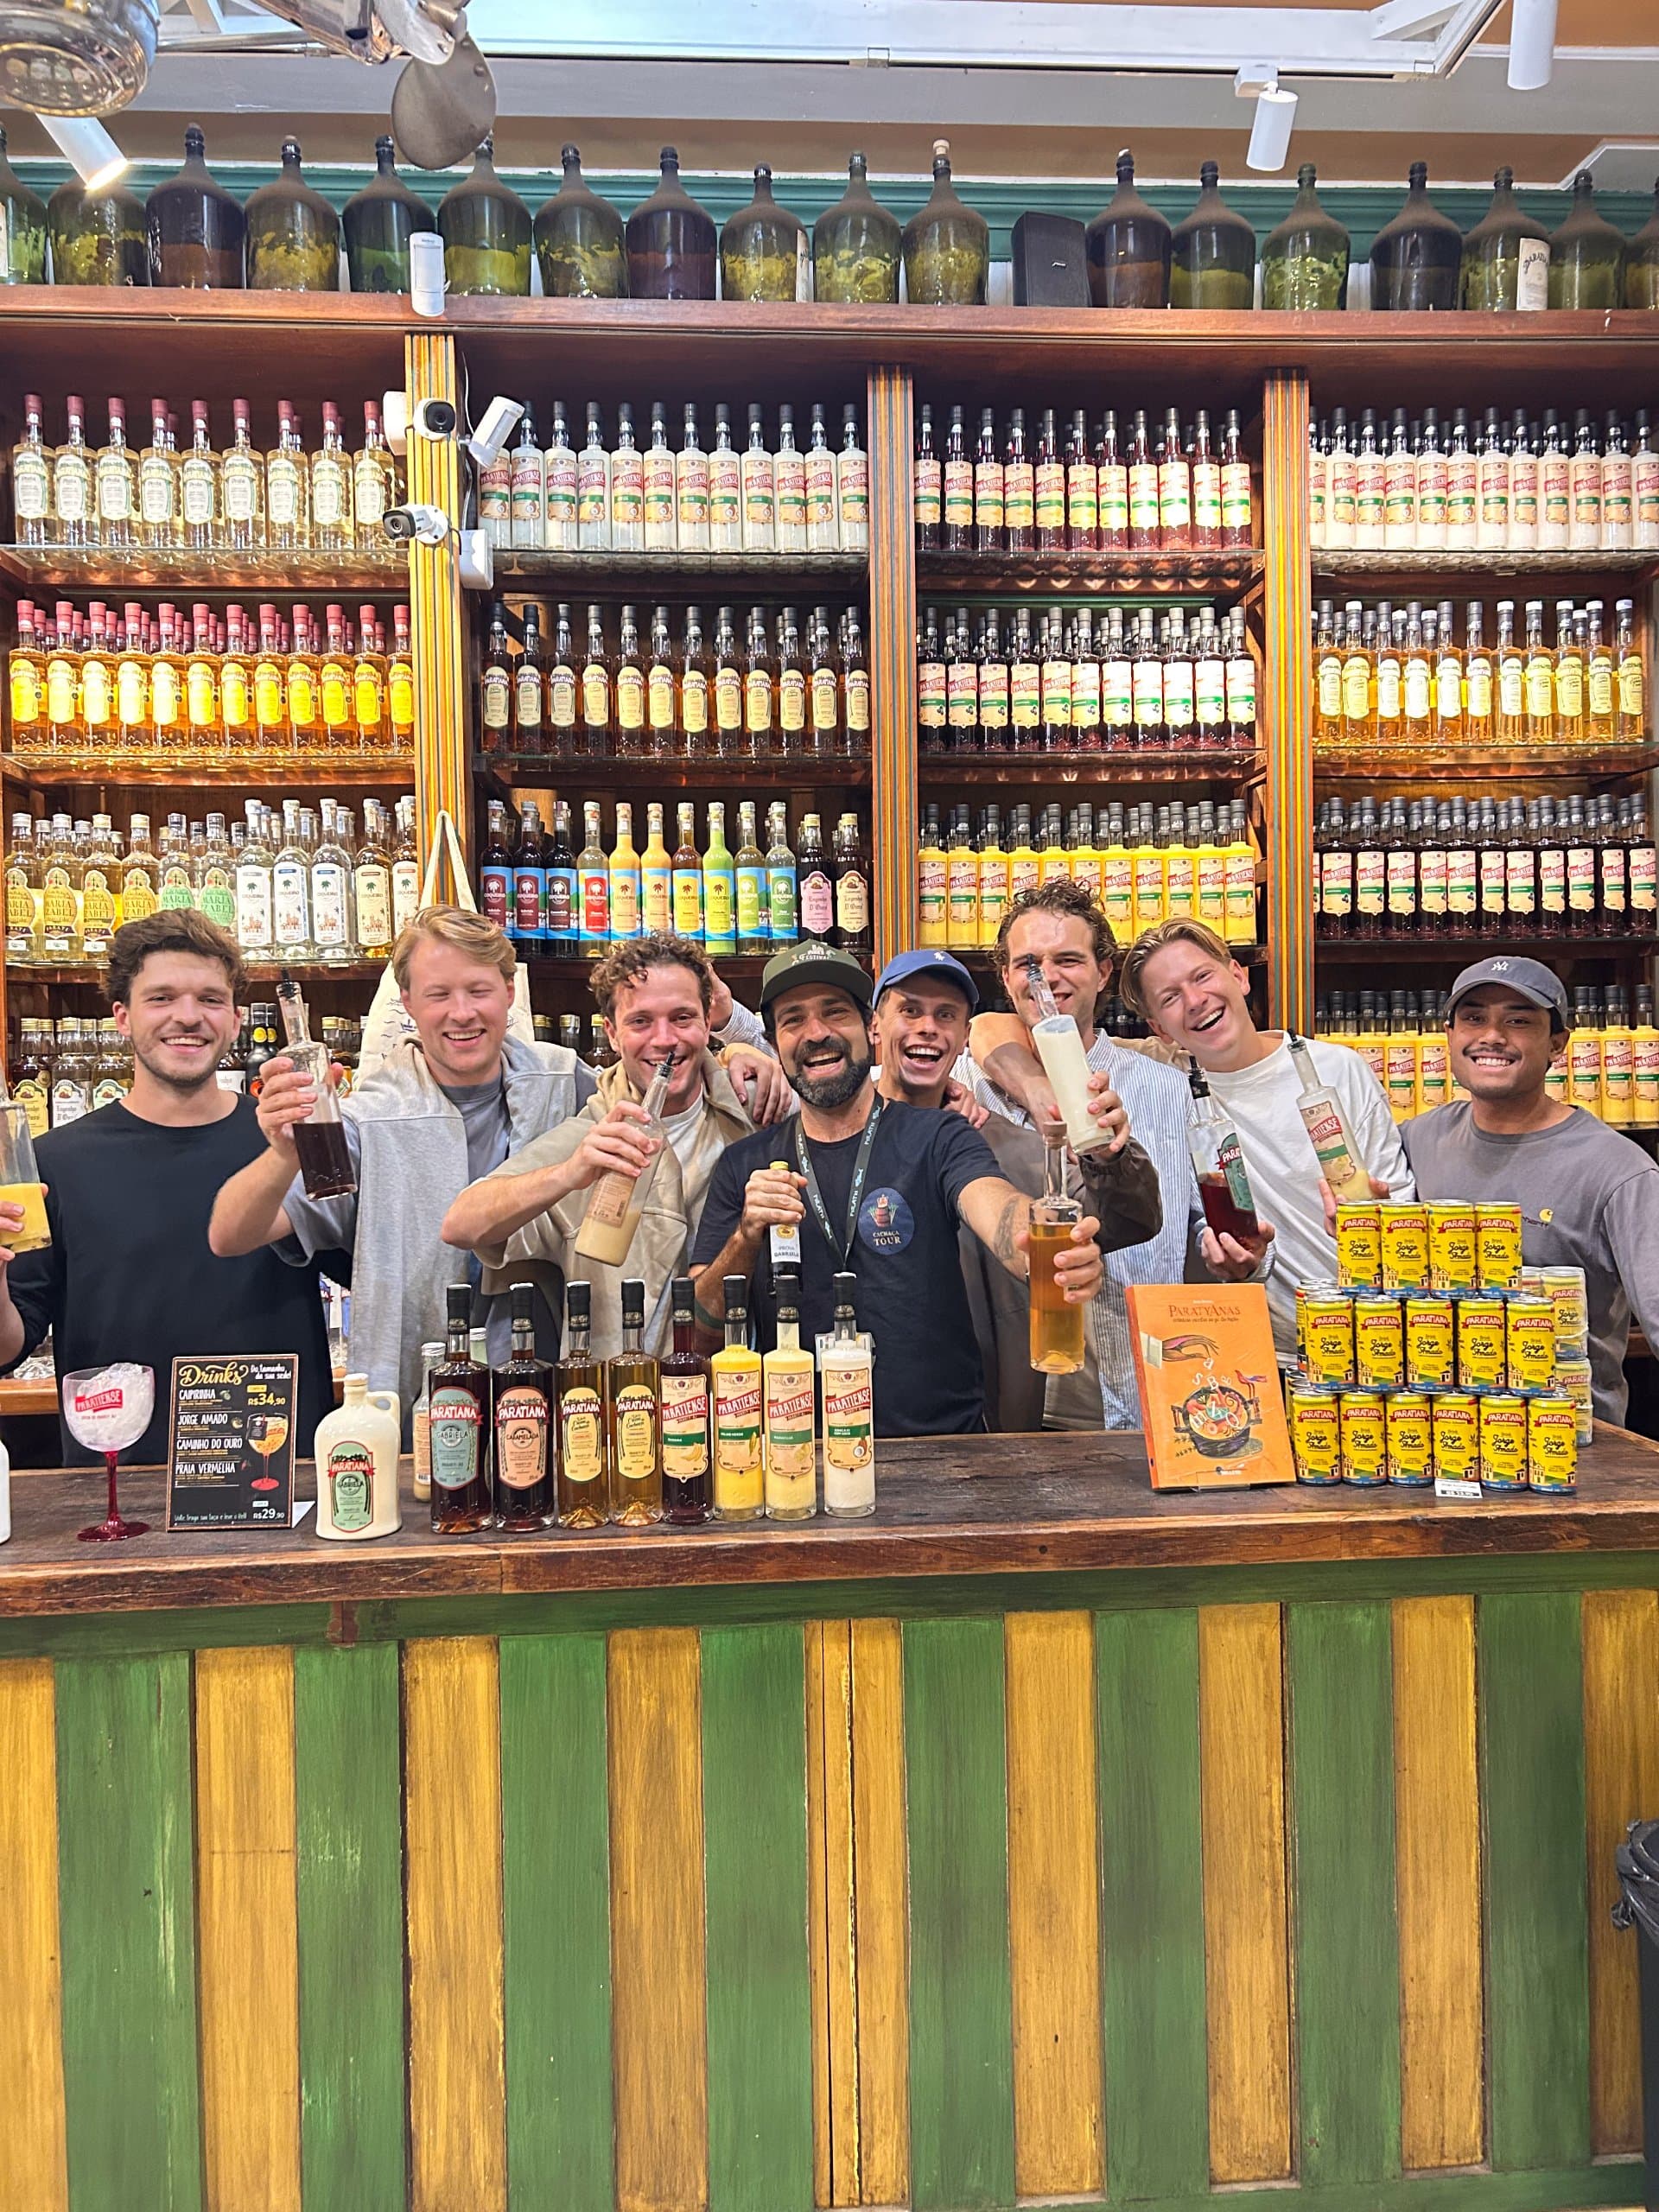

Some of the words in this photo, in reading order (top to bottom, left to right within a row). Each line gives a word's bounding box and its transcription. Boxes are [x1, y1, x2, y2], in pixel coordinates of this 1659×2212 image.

[874, 1236, 901, 1246] TOUR
[179, 1362, 249, 1387] Drinks
[77, 1390, 121, 1410] PARATIENSE
[179, 1389, 215, 1400] CAIPIRINHA
[248, 1393, 285, 1406] R$34,90
[827, 1388, 870, 1412] PARATIENSE
[563, 1403, 600, 1414] PARATIANA
[618, 1400, 654, 1412] PARATIANA
[663, 1396, 705, 1418] PARATIENSE
[718, 1391, 760, 1414] PARATIENSE
[769, 1392, 812, 1417] PARATIENSE
[431, 1405, 476, 1419] PARATIANA
[499, 1406, 545, 1419] PARATIANA
[178, 1414, 199, 1426] JORGE
[201, 1414, 228, 1425] AMADO
[437, 1430, 468, 1439] GABRIELA
[176, 1438, 209, 1450] CAMINHO
[211, 1439, 222, 1449] DO
[224, 1438, 242, 1449] OURO
[175, 1463, 196, 1475] PRAIA
[198, 1462, 235, 1474] VERMELHA
[332, 1461, 369, 1471] PARATIANA
[253, 1509, 285, 1519] R$29,90
